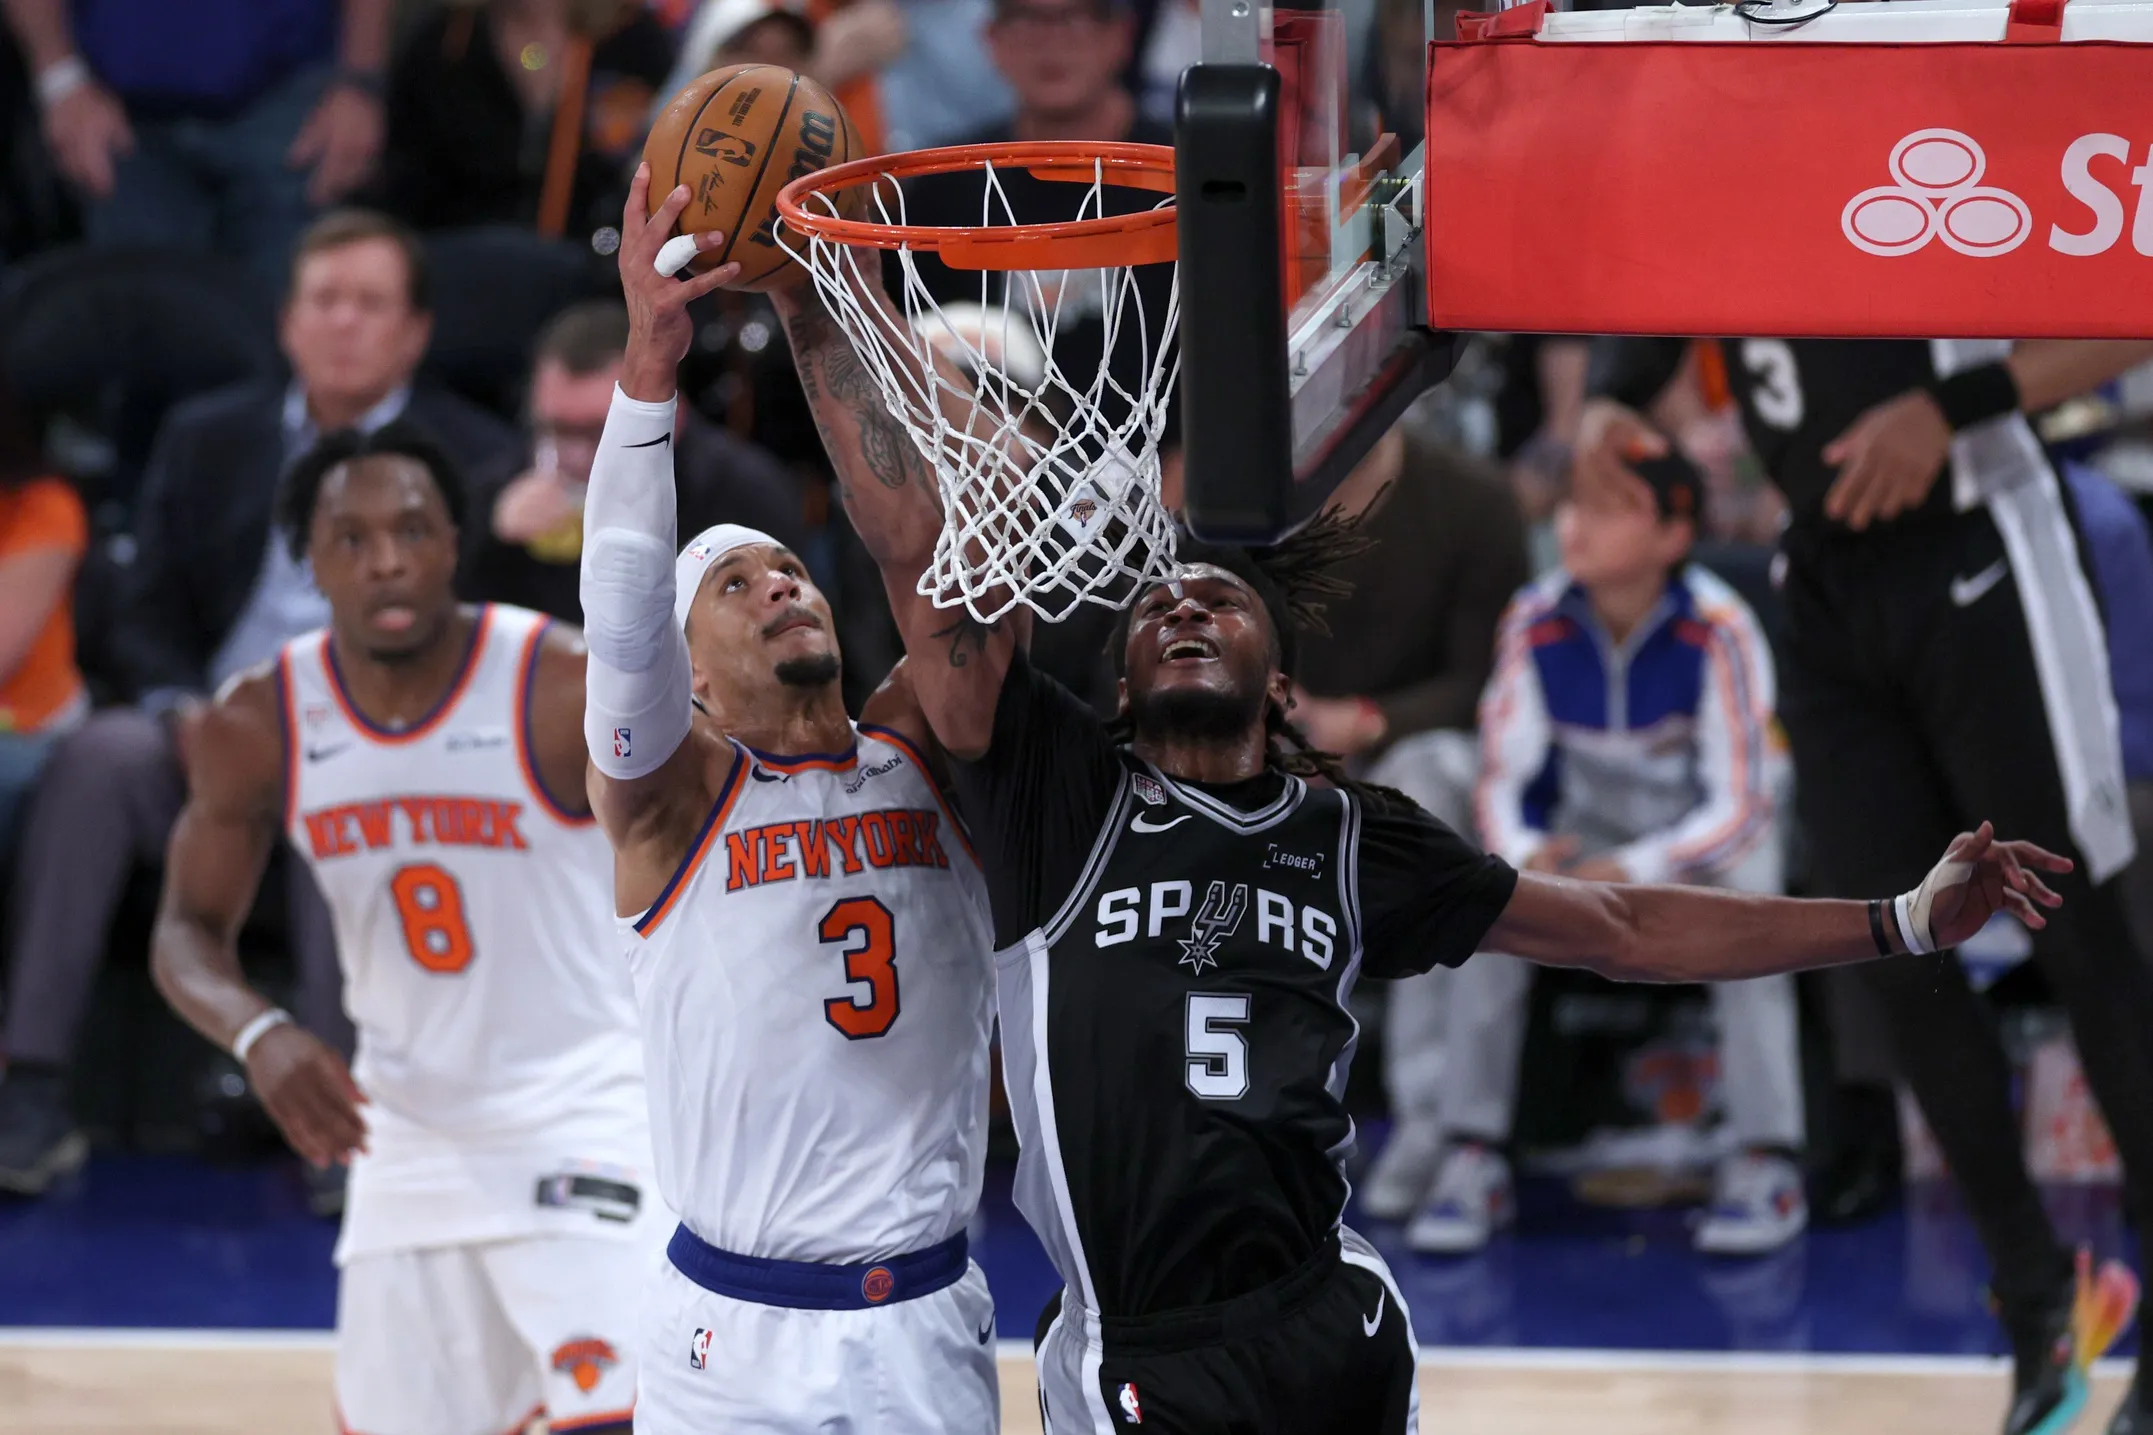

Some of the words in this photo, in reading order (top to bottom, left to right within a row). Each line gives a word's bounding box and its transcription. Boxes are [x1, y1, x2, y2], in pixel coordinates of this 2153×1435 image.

[1741, 338, 1804, 431] 3
[304, 799, 392, 862] NEW
[397, 794, 532, 852] YORK
[725, 817, 831, 895] NEW
[824, 806, 951, 878] YORK
[1271, 851, 1317, 871] LEDGER
[389, 862, 477, 976] 8
[1095, 879, 1338, 976] SPURS
[818, 894, 902, 1042] 3
[1184, 990, 1252, 1101] 5
